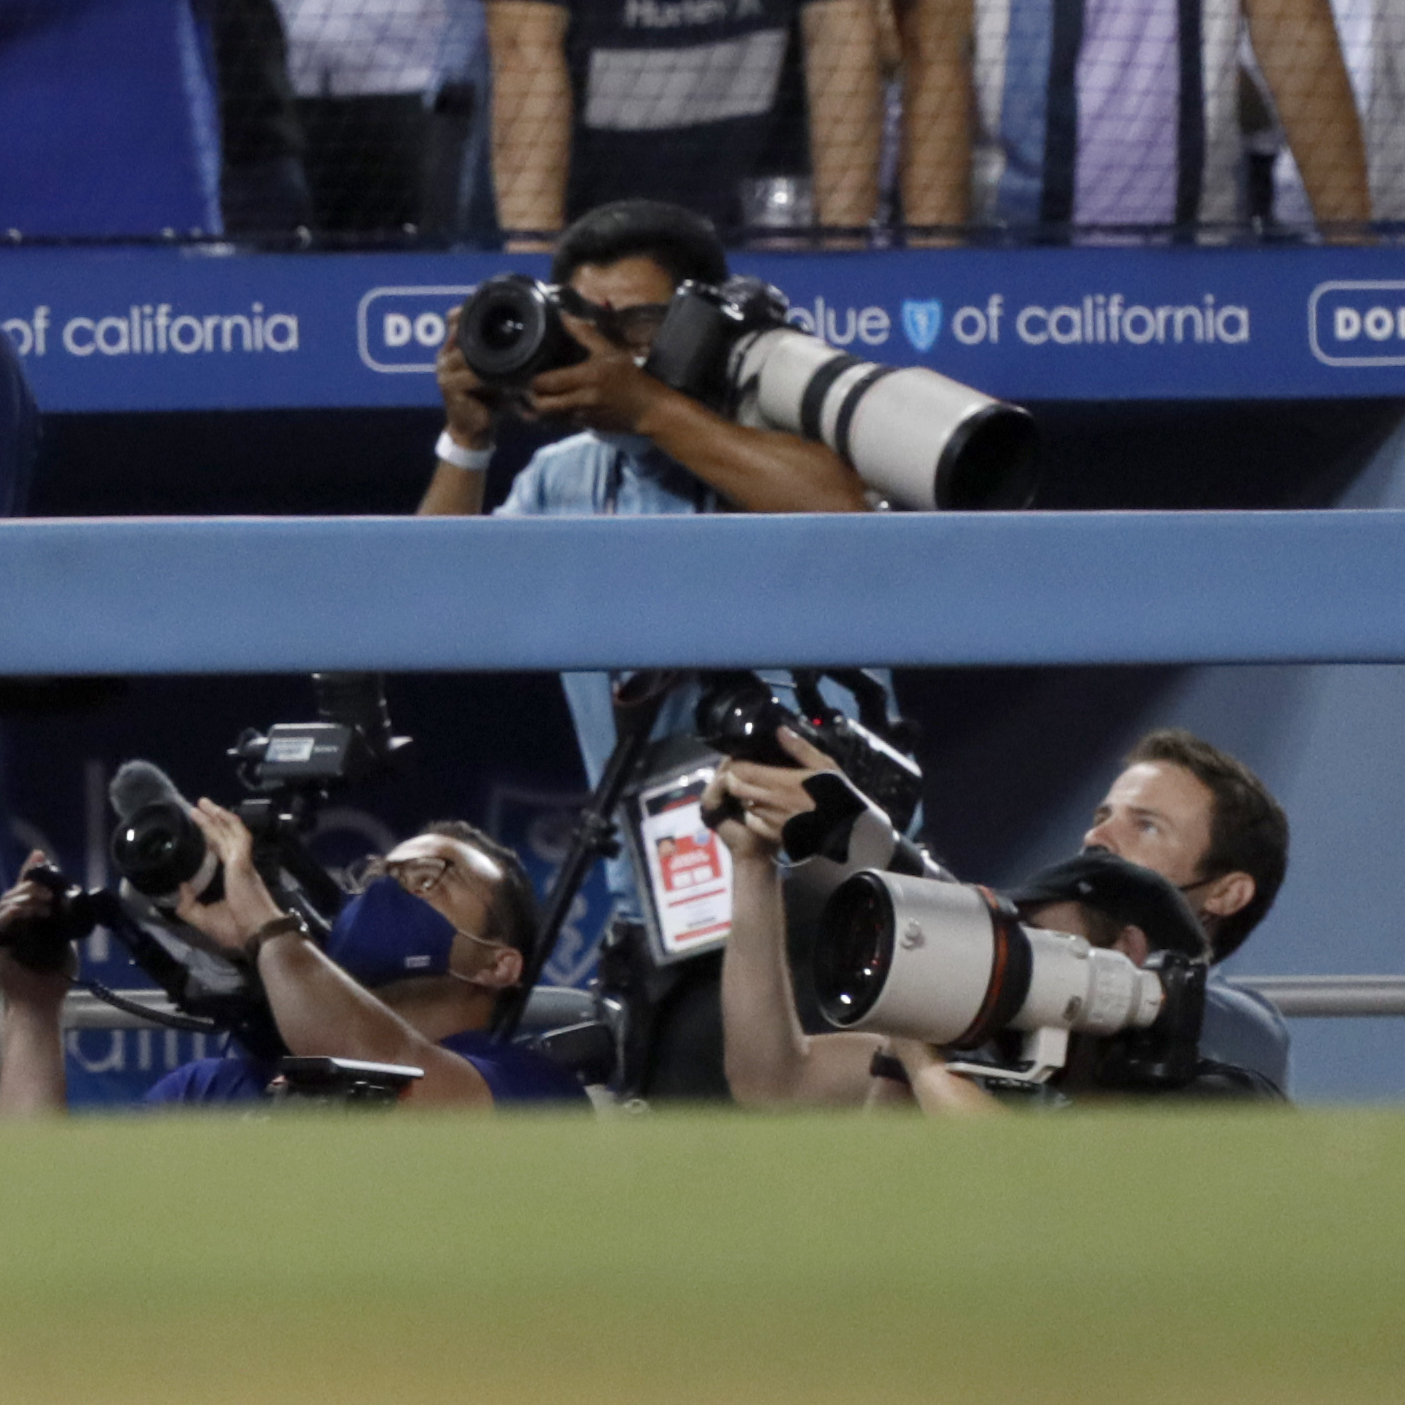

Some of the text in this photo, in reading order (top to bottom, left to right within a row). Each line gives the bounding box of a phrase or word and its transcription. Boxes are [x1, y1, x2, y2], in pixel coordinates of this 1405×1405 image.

[1, 302, 299, 357] of california
[384, 311, 446, 347] DO
[951, 295, 1004, 345] of
[1015, 293, 1250, 346] california
